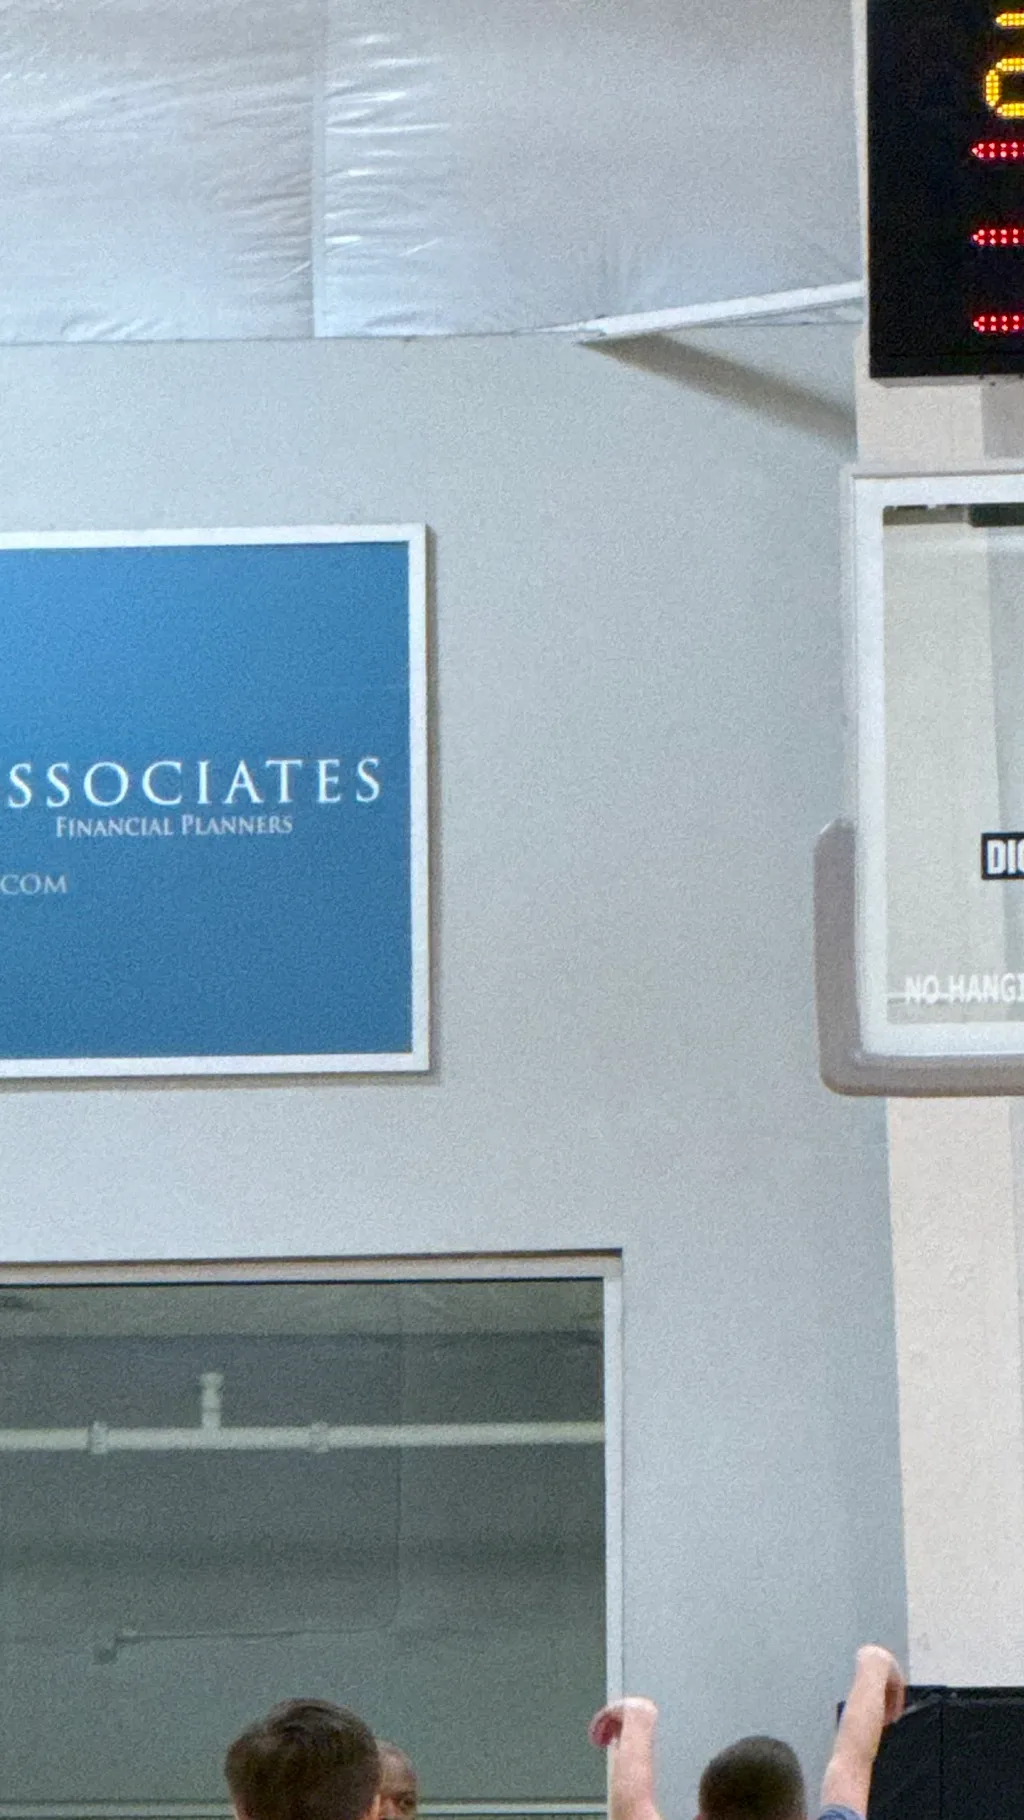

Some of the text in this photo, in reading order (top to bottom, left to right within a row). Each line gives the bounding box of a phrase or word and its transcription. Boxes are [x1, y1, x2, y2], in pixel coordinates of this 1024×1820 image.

[8, 757, 381, 809] SSOCIATES
[56, 813, 293, 839] FINANCIAL PLANNERS
[905, 975, 939, 1005] NO
